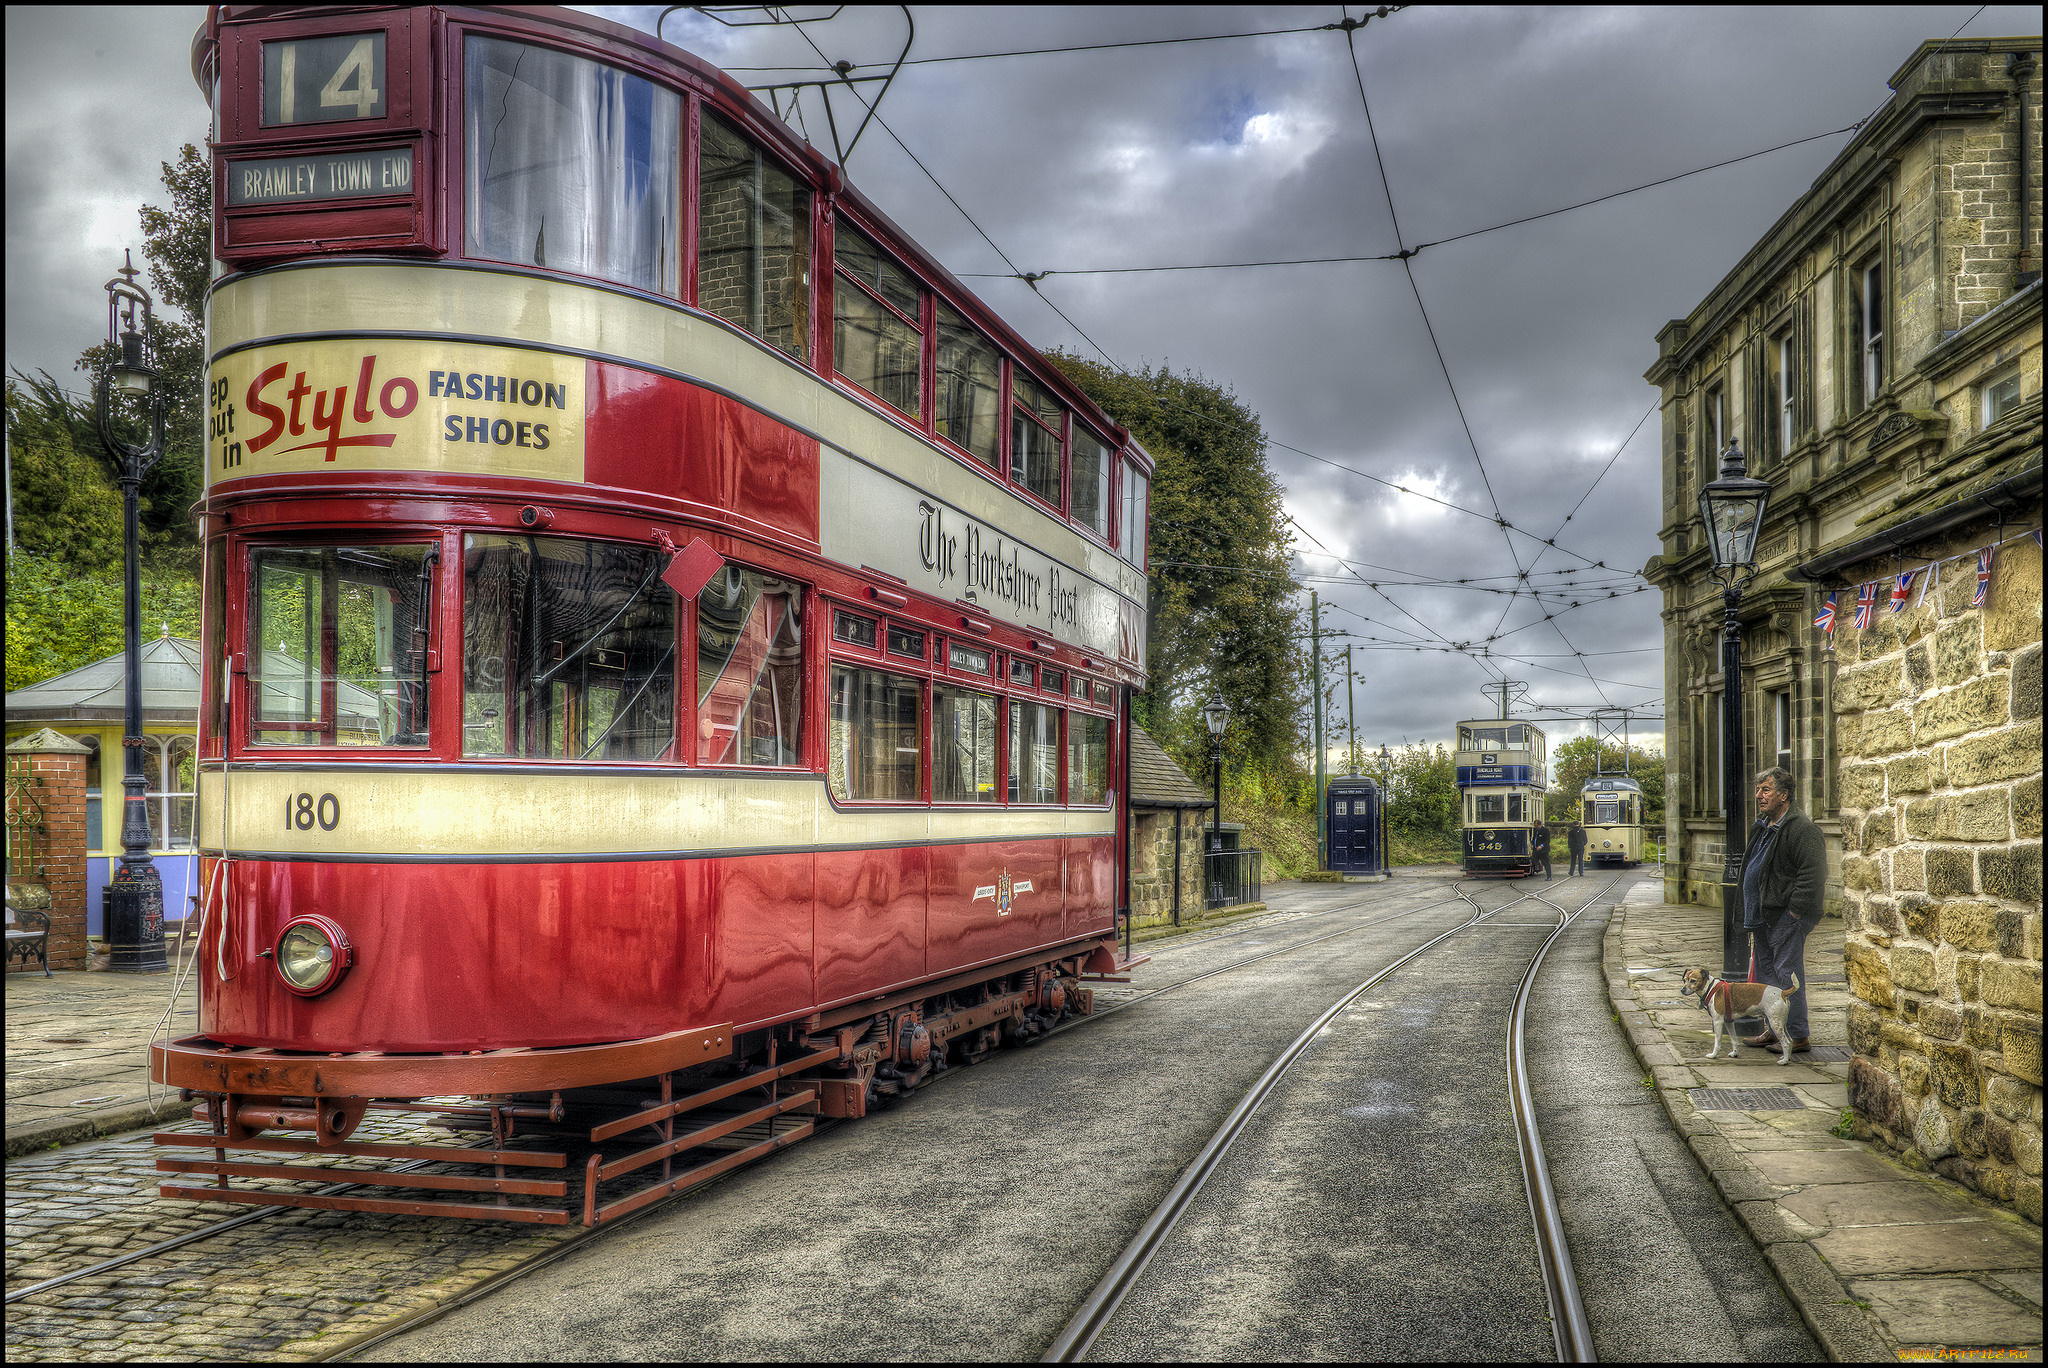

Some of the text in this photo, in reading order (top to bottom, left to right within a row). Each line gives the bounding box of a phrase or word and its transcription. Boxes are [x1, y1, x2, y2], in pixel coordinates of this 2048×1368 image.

[281, 38, 378, 123] 14
[244, 156, 410, 199] BRAMLEY TOWN END
[245, 355, 418, 462] Stylo
[429, 370, 566, 410] FASHION
[223, 437, 242, 469] in
[445, 415, 551, 450] SHOES
[918, 500, 1078, 629] The Yorkshire Post
[285, 793, 340, 831] 180
